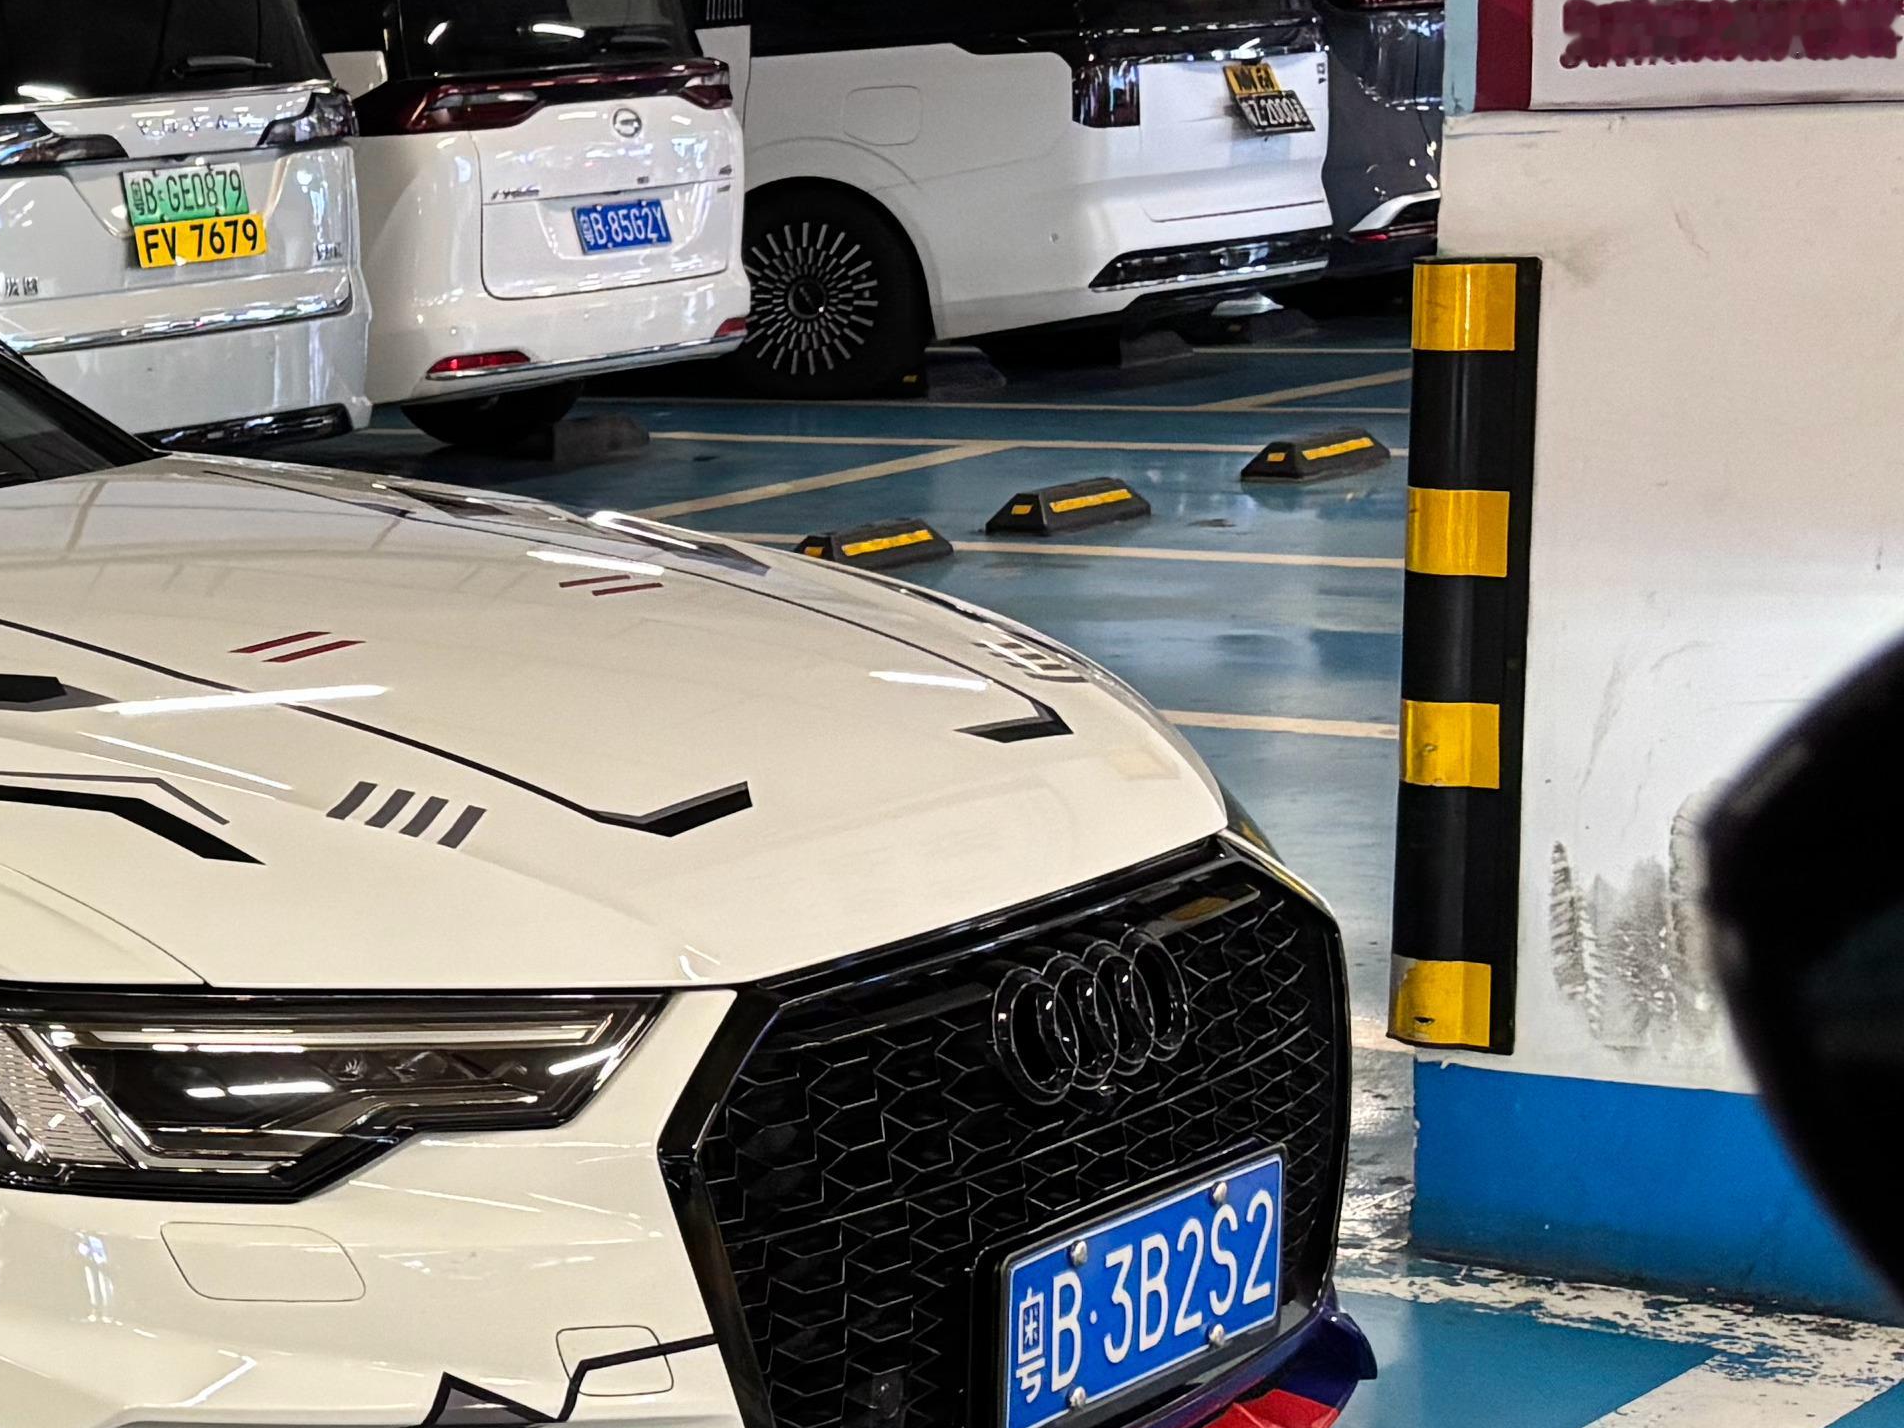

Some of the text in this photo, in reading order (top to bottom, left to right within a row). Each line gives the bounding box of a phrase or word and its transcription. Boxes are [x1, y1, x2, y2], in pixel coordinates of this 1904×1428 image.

[143, 219, 258, 264] FV 7679
[1015, 1189, 1275, 1404] 粤B·3B2S2
